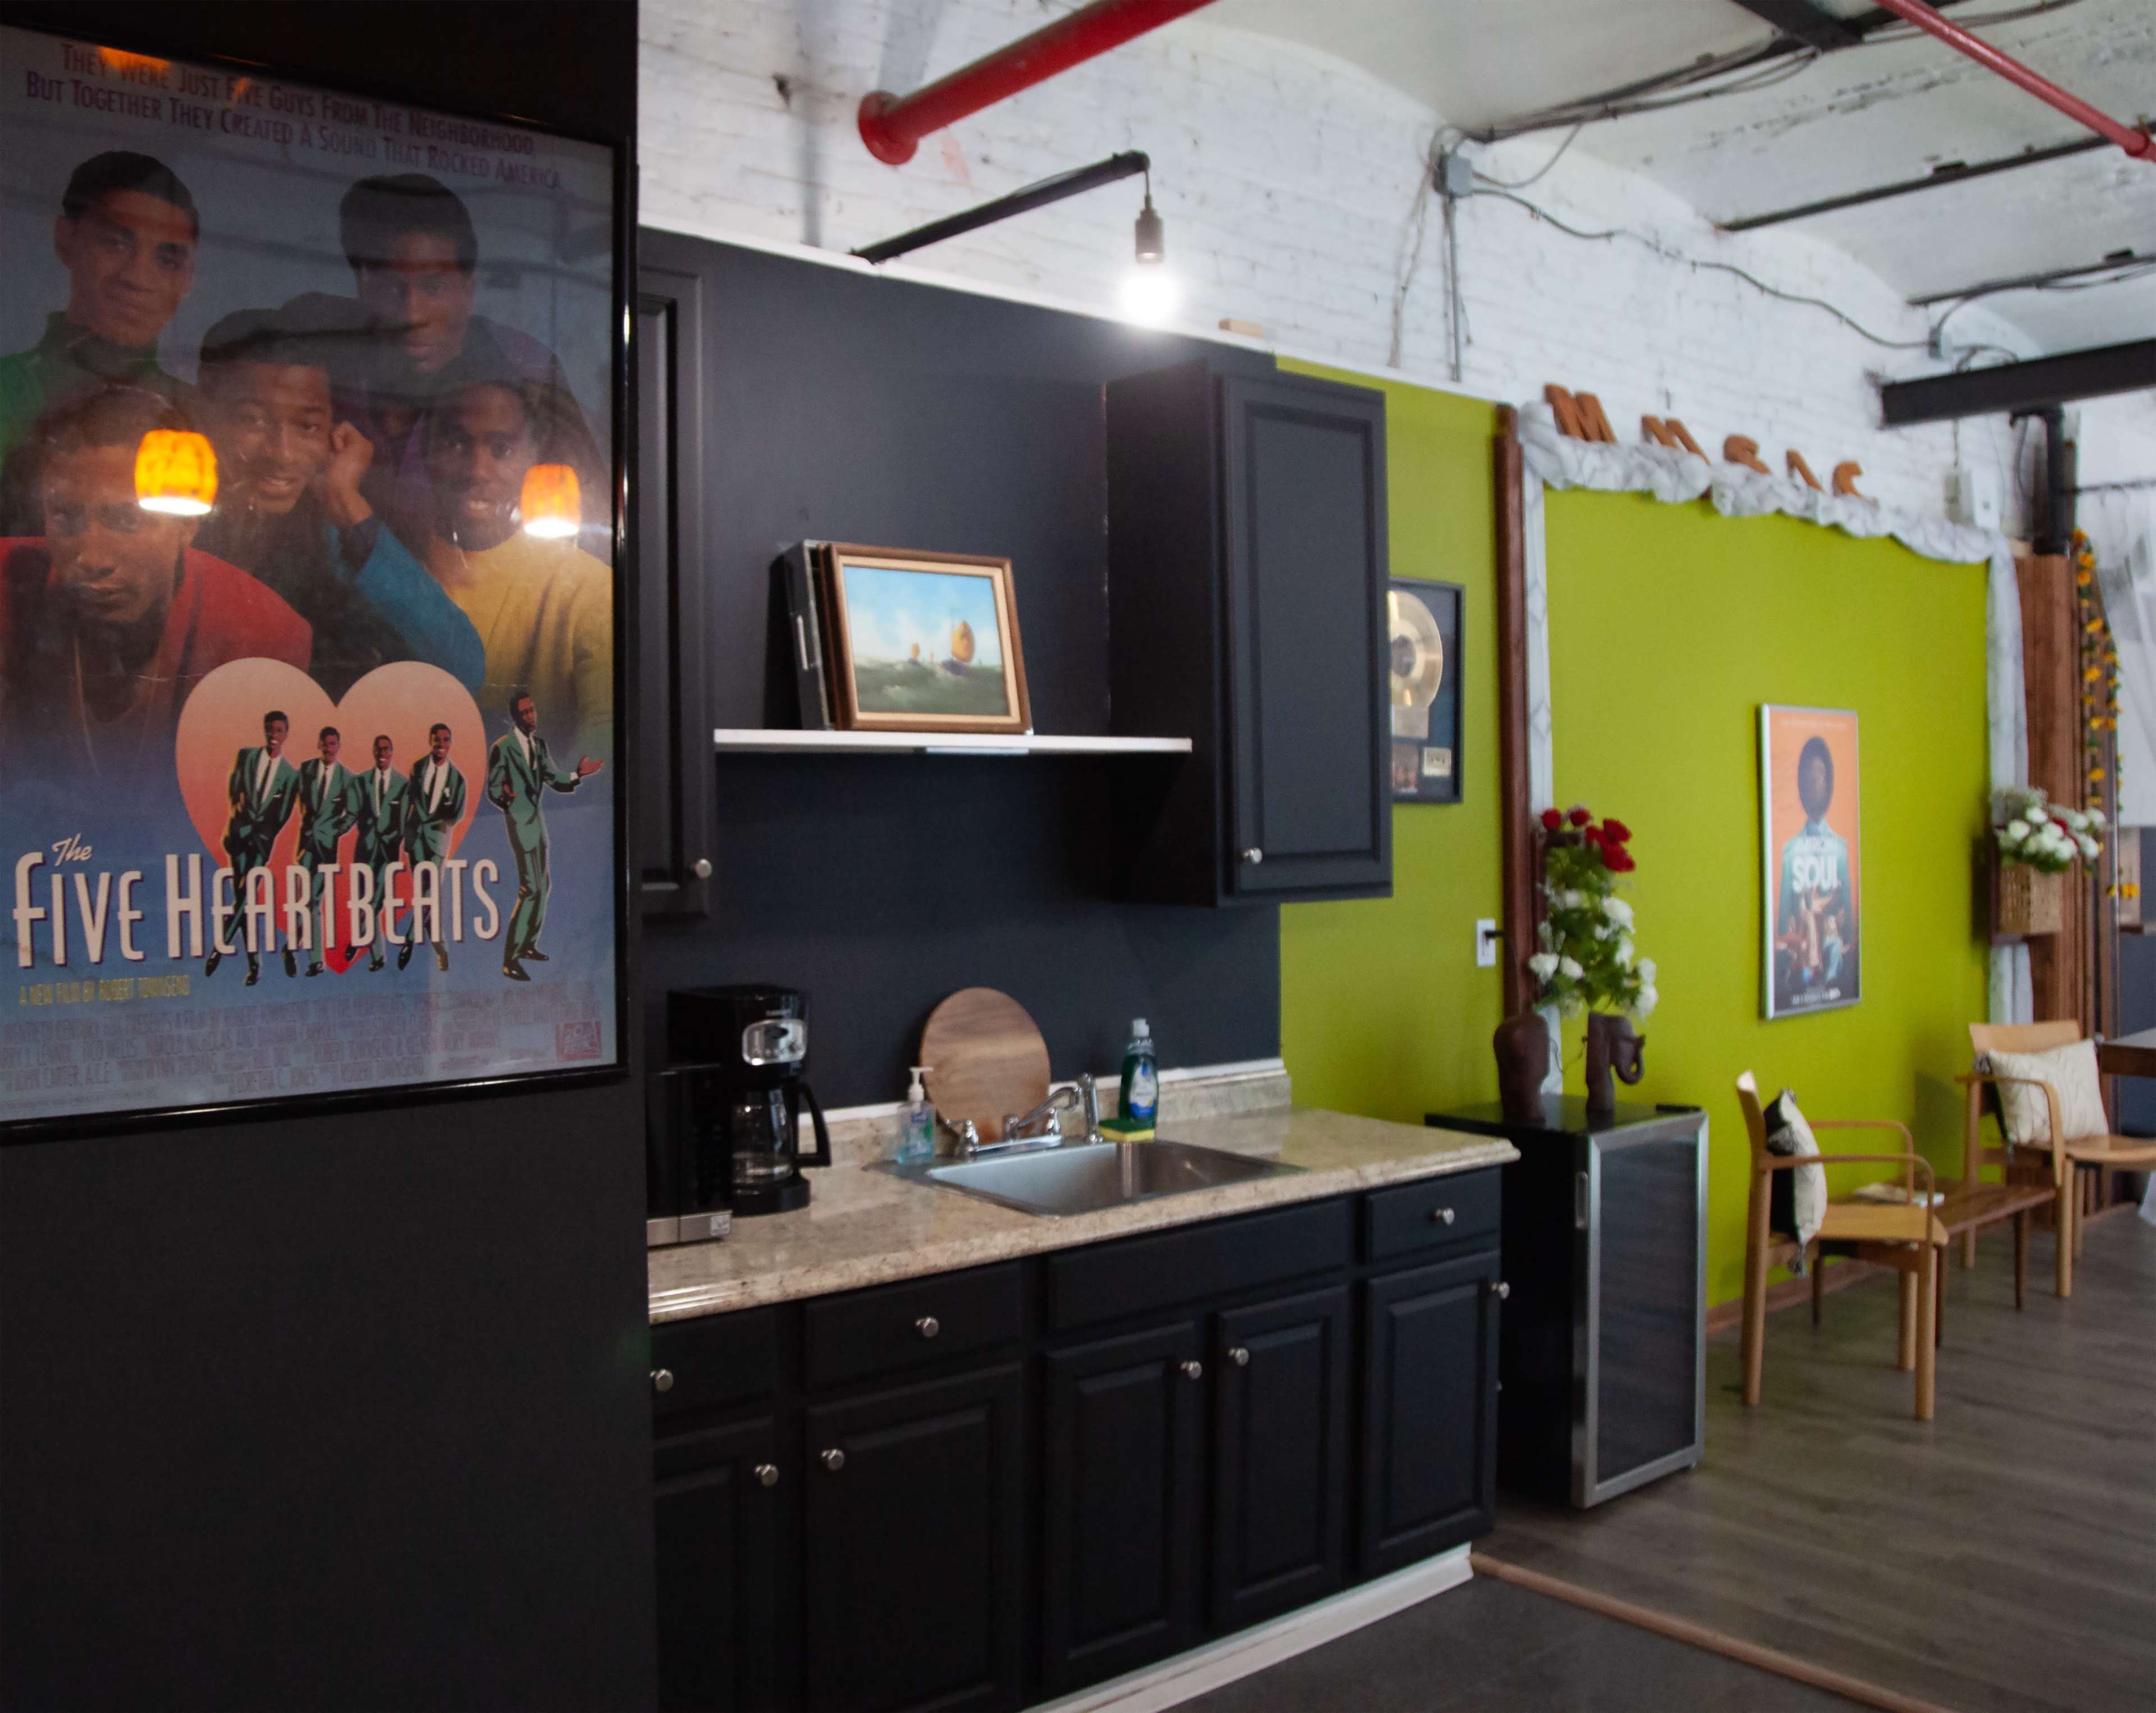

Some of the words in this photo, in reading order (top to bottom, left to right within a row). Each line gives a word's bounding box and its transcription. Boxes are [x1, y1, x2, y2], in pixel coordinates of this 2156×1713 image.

[26, 70, 65, 103] BUT
[70, 78, 162, 122] TOGETHER
[168, 96, 213, 131] THEY
[220, 107, 294, 145] CREATED
[299, 120, 313, 148] A
[318, 124, 377, 159] SOUND
[381, 135, 420, 168] THAT
[427, 144, 490, 178] ROCKED
[60, 43, 107, 77] THEY
[178, 66, 220, 99] JUST
[270, 86, 314, 117] GUYS
[322, 92, 368, 125] FROM
[373, 103, 402, 134] THE
[410, 111, 534, 154] NEIGHBORHOOD
[52, 833, 92, 866] The
[1792, 855, 1842, 894] SOUL
[12, 852, 145, 969] FIVE
[165, 853, 500, 958] HEARTBEATS
